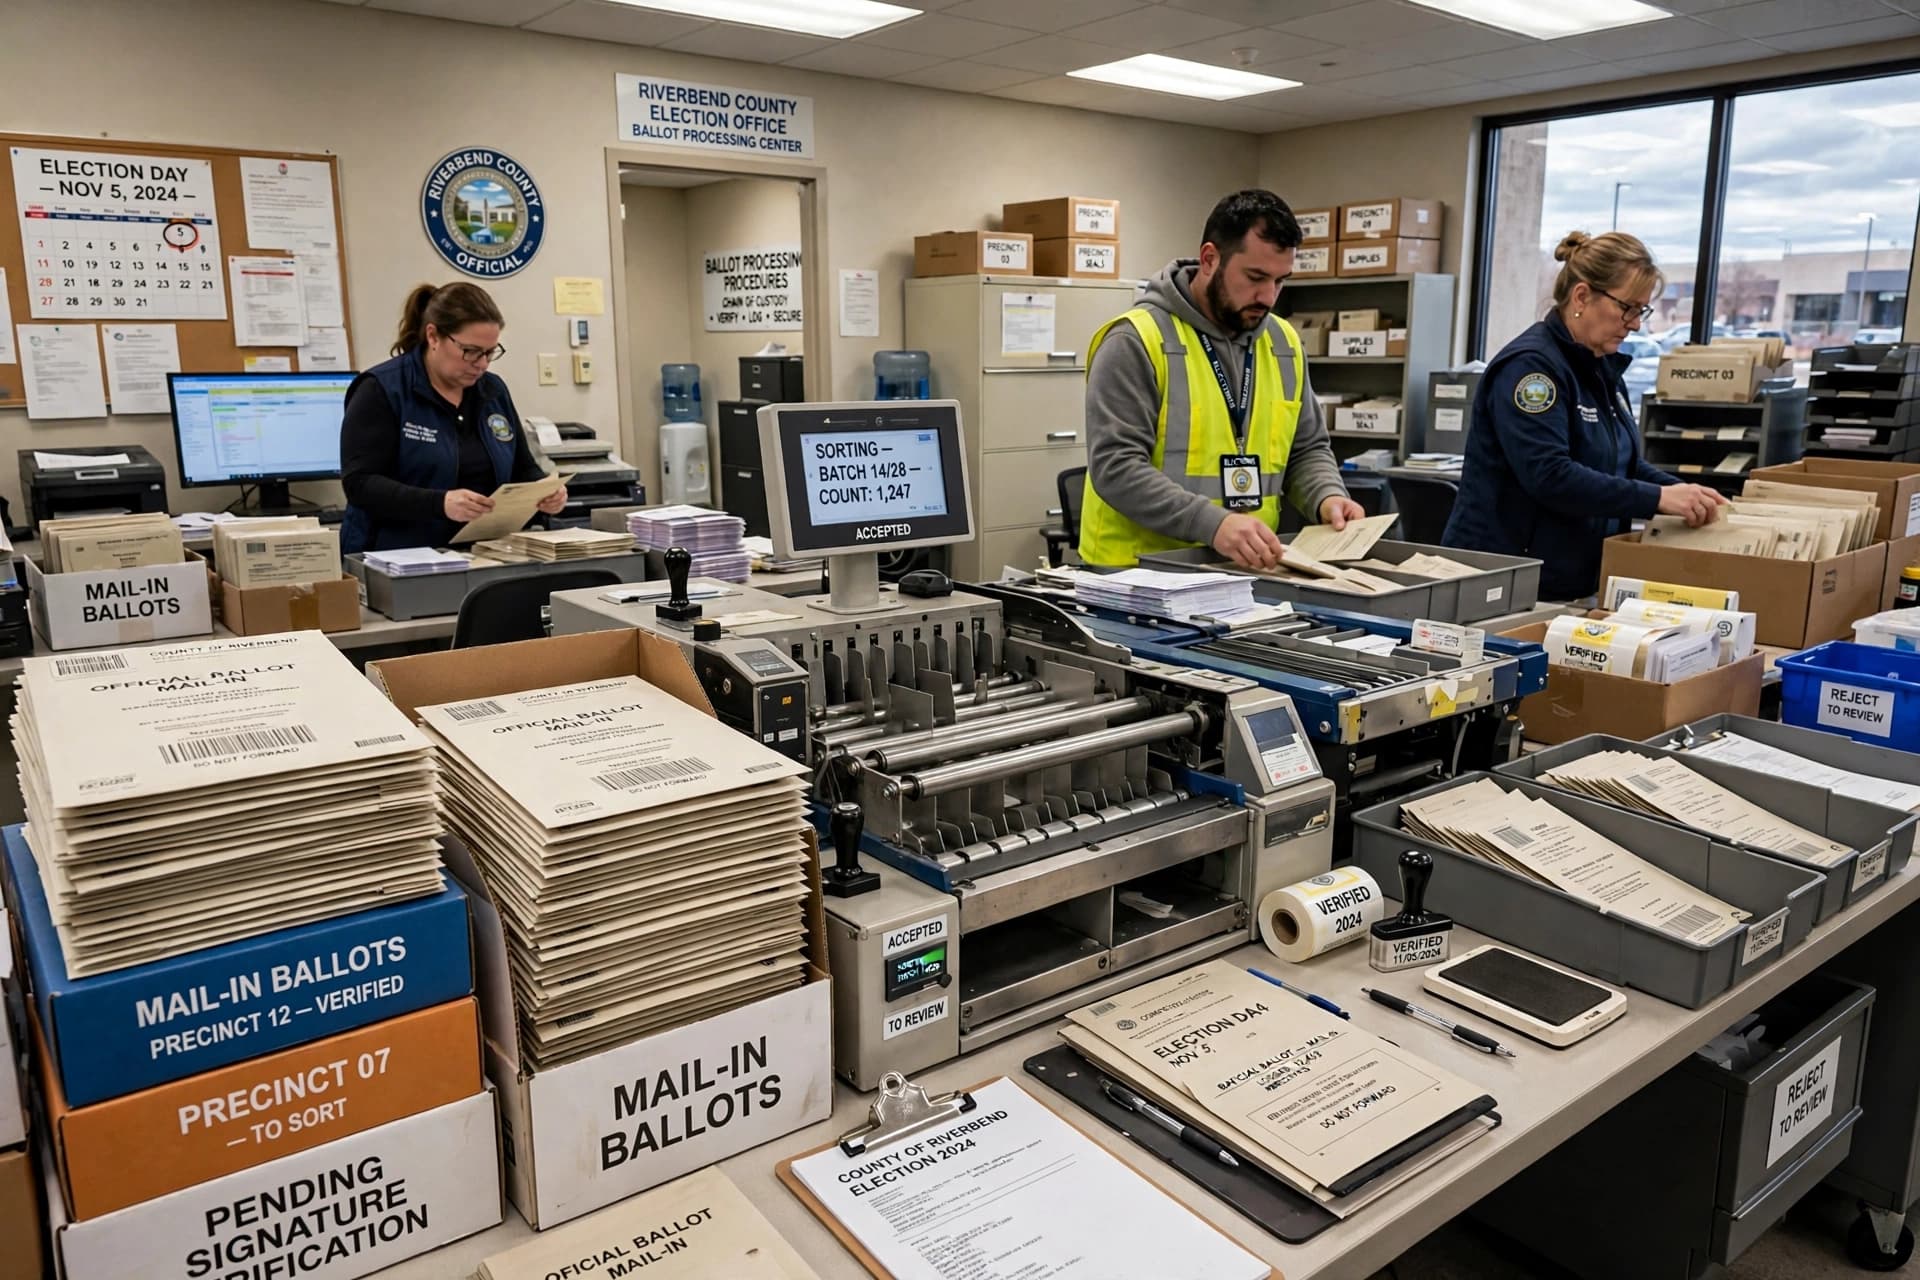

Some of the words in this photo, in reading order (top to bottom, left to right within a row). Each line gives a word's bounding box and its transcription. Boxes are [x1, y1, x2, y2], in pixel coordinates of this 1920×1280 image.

[639, 82, 731, 108] RIVERBEND
[735, 94, 797, 116] COUNTY
[650, 105, 728, 129] ELECTION
[733, 114, 787, 135] OFFICE
[633, 123, 680, 141] BALLOT
[683, 129, 756, 149] PROCESSING
[759, 137, 802, 153] CENTER
[40, 158, 144, 181] ELECTION
[150, 165, 189, 183] DAY
[428, 152, 494, 200] RIVERBEND
[496, 157, 540, 207] COUNTY
[59, 181, 103, 197] NOV
[111, 185, 127, 202] 5,
[133, 186, 179, 202] 2024
[62, 241, 70, 250] 2
[86, 242, 93, 250] 4
[109, 242, 116, 250] 5
[176, 227, 184, 237] 5
[62, 260, 74, 268] 10
[109, 261, 121, 269] 12
[132, 261, 144, 270] 13
[156, 262, 167, 270] 14
[178, 262, 189, 271] 15
[456, 251, 523, 273] OFFICIAL
[706, 257, 741, 274] BALLOT
[64, 278, 75, 287] 21
[134, 279, 147, 288] 24
[157, 280, 169, 289] 23
[179, 280, 190, 289] 22
[724, 273, 789, 292] PROCEDURES
[717, 312, 739, 324] VERIFY
[1670, 369, 1719, 380] PRECINCT
[1722, 370, 1735, 380] 03
[815, 441, 878, 459] SORTING
[819, 464, 866, 482] BATCH
[870, 462, 907, 480] 14/28
[819, 487, 872, 505] COUNT:
[877, 484, 911, 503] 1,247
[856, 523, 911, 541] ACCEPTED
[85, 577, 170, 601] MAIL-IN
[82, 597, 181, 623] BALLOTS
[90, 674, 201, 693] OFFICIAL
[210, 663, 296, 679] BALLOT
[157, 675, 247, 692] MAIL-IN
[1830, 688, 1880, 707] REJECT
[492, 715, 573, 736] OFFICIAL
[575, 703, 644, 719] BALLOT
[1827, 703, 1841, 716] TO
[1843, 707, 1884, 724] REVIEW
[1316, 885, 1371, 916] VERIFIED
[888, 921, 943, 949] ACCEPTED
[1336, 911, 1363, 934] 2024
[1393, 935, 1444, 954] VERIFIED
[135, 972, 263, 1029] MAIL-IN
[270, 936, 408, 994] BALLOTS
[150, 1012, 261, 1060] PRECINCT
[268, 1005, 292, 1028] 12
[314, 975, 405, 1015] VERIFIED
[888, 1018, 902, 1032] TO
[905, 1001, 944, 1027] REVIEW
[1153, 1017, 1236, 1059] ELECTION
[1169, 1051, 1199, 1068] NOV
[178, 1059, 349, 1135] PRECINCT
[357, 1047, 392, 1080] 07
[613, 1035, 768, 1121] MAIL-IN
[1787, 1060, 1827, 1106] REJECT
[250, 1119, 283, 1145] TO
[287, 1098, 349, 1133] SORT
[1319, 1118, 1336, 1129] DO
[1336, 1106, 1352, 1121] NOT
[1352, 1085, 1397, 1111] FORWARD
[1780, 1115, 1792, 1137] TO
[1793, 1084, 1829, 1127] REVIEW
[600, 1074, 782, 1172] BALLOTS
[837, 1152, 900, 1185] COUNTY
[904, 1142, 925, 1157] OF
[927, 1109, 1008, 1149] RIVERBEND
[849, 1155, 937, 1197] ELECTION
[937, 1138, 977, 1160] 2024
[205, 1155, 384, 1237] PENDING
[186, 1178, 408, 1279] SIGNATURE
[632, 1207, 713, 1249] BALLOT
[606, 1237, 688, 1280] MAIL-IN
